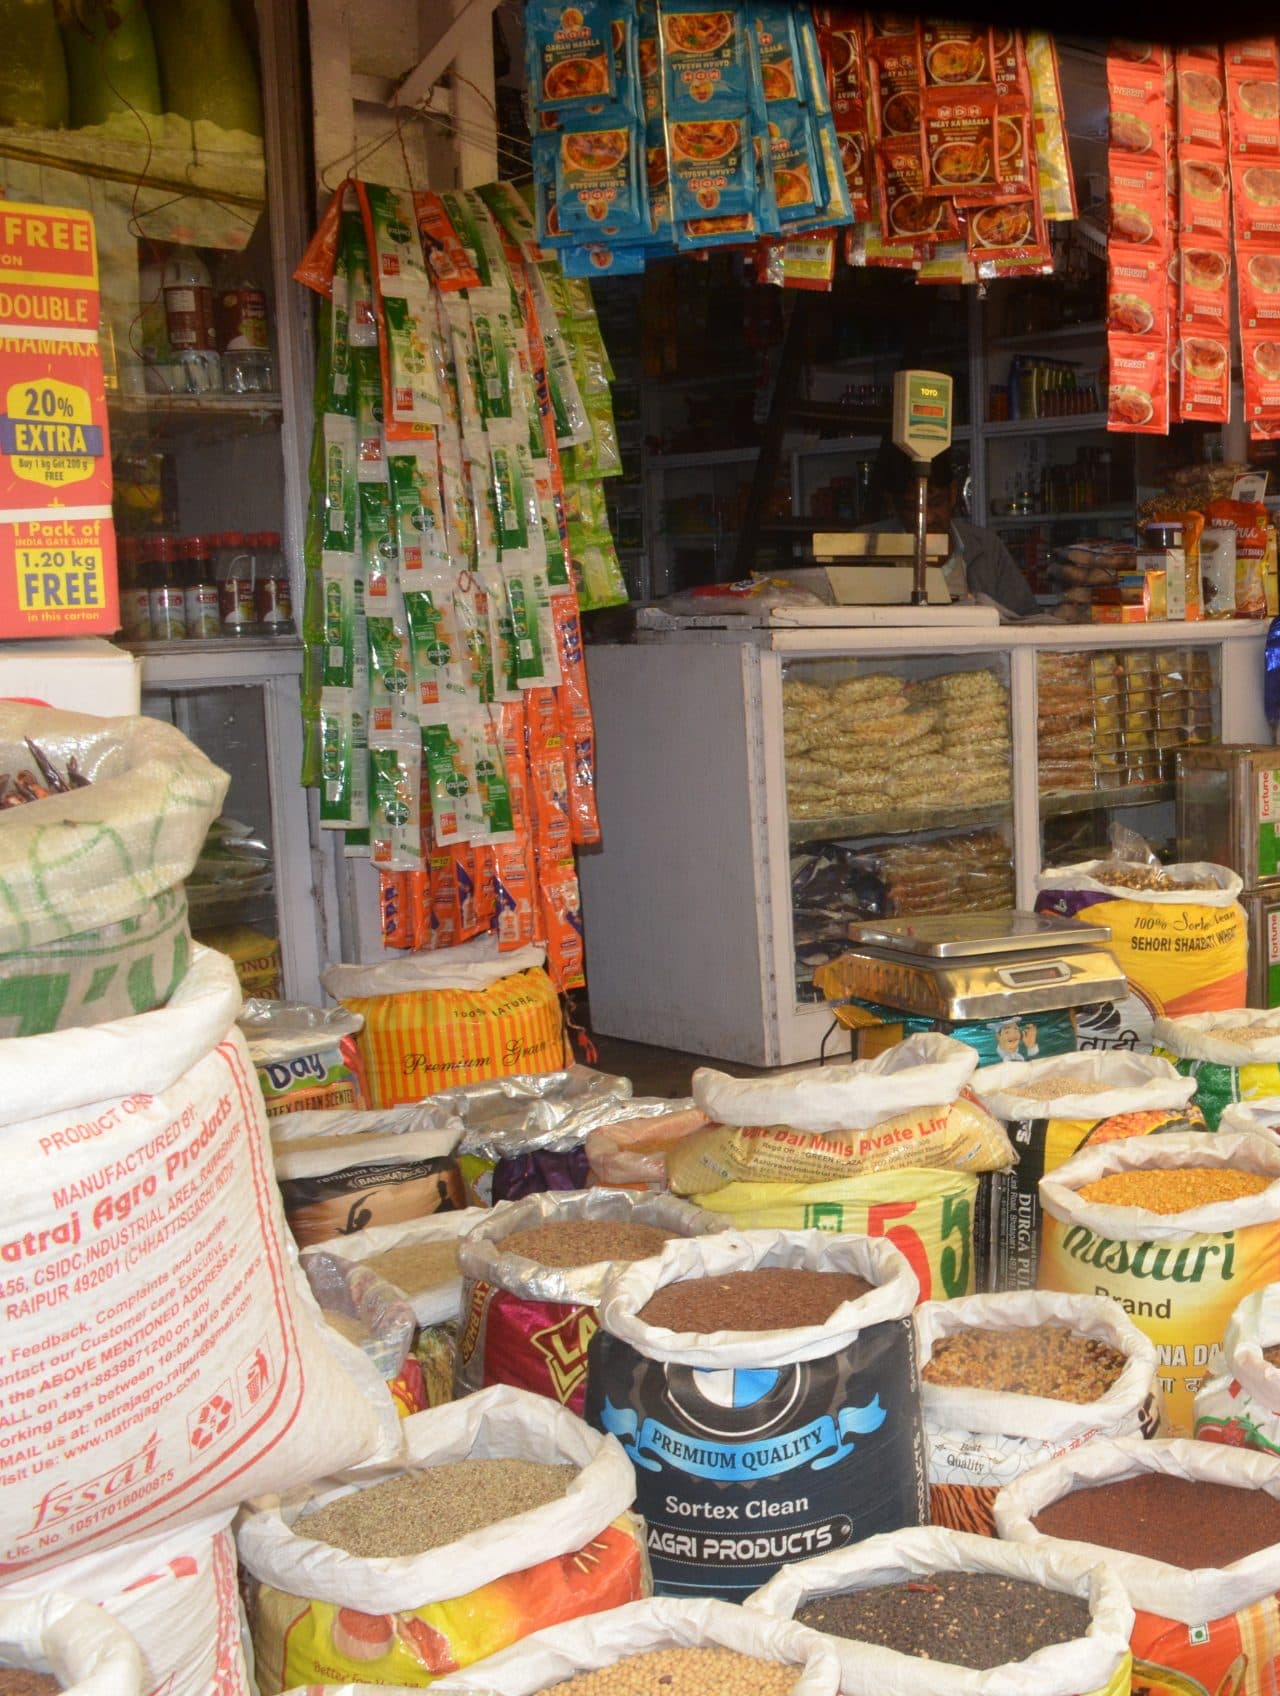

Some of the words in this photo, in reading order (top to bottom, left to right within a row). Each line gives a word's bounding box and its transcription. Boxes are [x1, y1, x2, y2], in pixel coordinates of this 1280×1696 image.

[5, 217, 89, 252] FREE
[0, 294, 88, 323] DOUBLE
[25, 388, 74, 417] 20%
[15, 424, 88, 453] EXTRA
[19, 458, 33, 470] Buy
[52, 459, 65, 469] Get
[66, 459, 80, 469] 200
[45, 471, 64, 481] FREE
[16, 538, 42, 547] INDIA
[46, 538, 69, 547] GATE
[71, 537, 99, 547] SUPER
[29, 521, 75, 537] Pack
[82, 521, 101, 537] of
[23, 552, 65, 568] 1.20
[72, 551, 96, 570] kg
[25, 572, 99, 607] FREE
[28, 613, 38, 622] in
[41, 611, 61, 622] this
[64, 612, 99, 622] carton
[1134, 916, 1167, 930] 100%
[1173, 911, 1209, 932] Sorte
[1271, 913, 1279, 960] fortune
[1131, 936, 1171, 951] SEHORI
[492, 995, 538, 1017] ATURA
[265, 1053, 328, 1090] Day
[403, 1054, 490, 1076] Premium
[502, 1039, 547, 1066] Grain
[38, 1107, 121, 1155] PRODUCT
[810, 1135, 854, 1158] Mills
[859, 1127, 914, 1157] Pivate
[0, 1211, 81, 1263] atraj
[93, 1174, 157, 1232] Agro
[166, 1094, 232, 1182] Products
[52, 1121, 181, 1210] MANUFACTURED
[1017, 1193, 1032, 1253] DURGA
[5, 1284, 70, 1321] RAIPUR
[73, 1259, 122, 1295] 492001
[95, 1271, 169, 1326] Complaints
[172, 1250, 192, 1275] and
[1016, 1257, 1030, 1291] PUL
[9, 1388, 35, 1404] the
[39, 1358, 97, 1394] ABOVE
[100, 1302, 181, 1363] MENTIONED
[182, 1253, 229, 1307] ADDRESS
[50, 1350, 76, 1367] our
[80, 1308, 147, 1353] Customer
[151, 1287, 176, 1312] care
[0, 1409, 33, 1429] ALL
[37, 1400, 58, 1415] on
[175, 1319, 190, 1336] on
[192, 1296, 210, 1321] any
[0, 1421, 53, 1448] orking
[57, 1403, 94, 1426] days
[97, 1365, 154, 1405] between
[158, 1336, 189, 1366] 10:00
[192, 1318, 209, 1341] AM
[210, 1308, 220, 1323] to
[32, 1457, 59, 1475] Us:
[63, 1368, 201, 1460] www.natrajagro.com
[0, 1447, 42, 1467] MAIL
[47, 1436, 66, 1451] us
[70, 1424, 89, 1440] at:
[651, 1429, 736, 1470] PREMIUM
[742, 1425, 824, 1469] QUALITY
[946, 1454, 985, 1474] Quality
[666, 1495, 739, 1519] Sortex
[745, 1497, 809, 1518] Clean
[648, 1529, 697, 1559] AGRI
[702, 1525, 832, 1560] PRODUCTS
